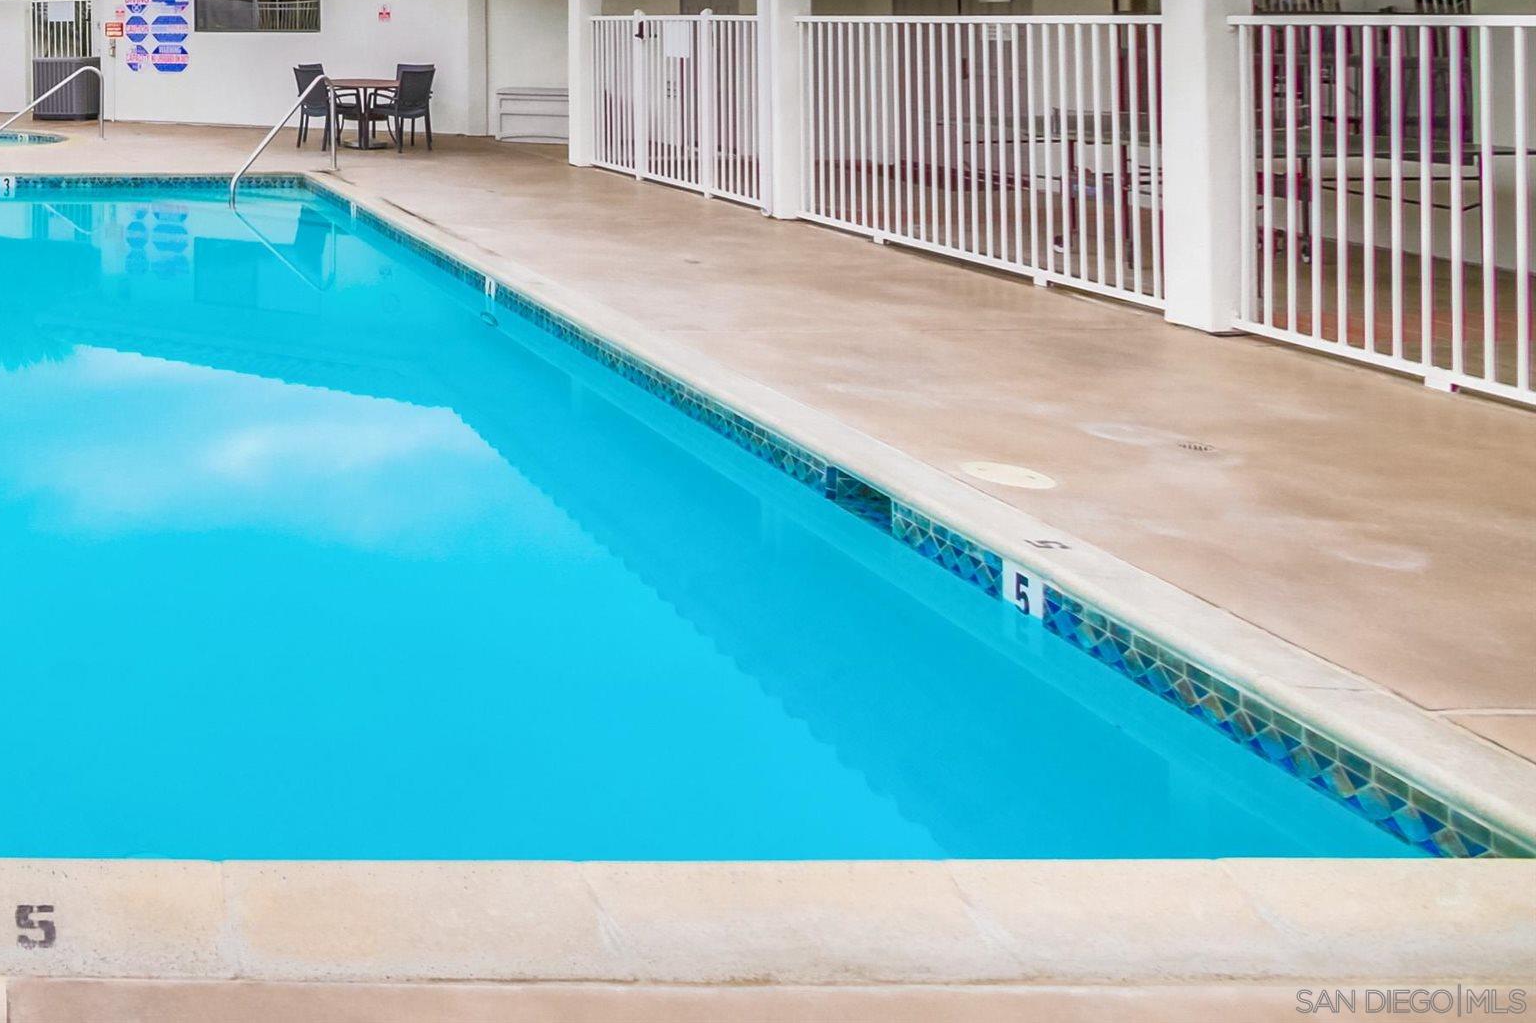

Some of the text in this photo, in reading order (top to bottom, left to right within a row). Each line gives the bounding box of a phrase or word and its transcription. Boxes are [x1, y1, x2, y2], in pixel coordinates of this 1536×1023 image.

[4, 178, 10, 197] 3
[1015, 572, 1030, 615] 5
[15, 904, 56, 949] 5
